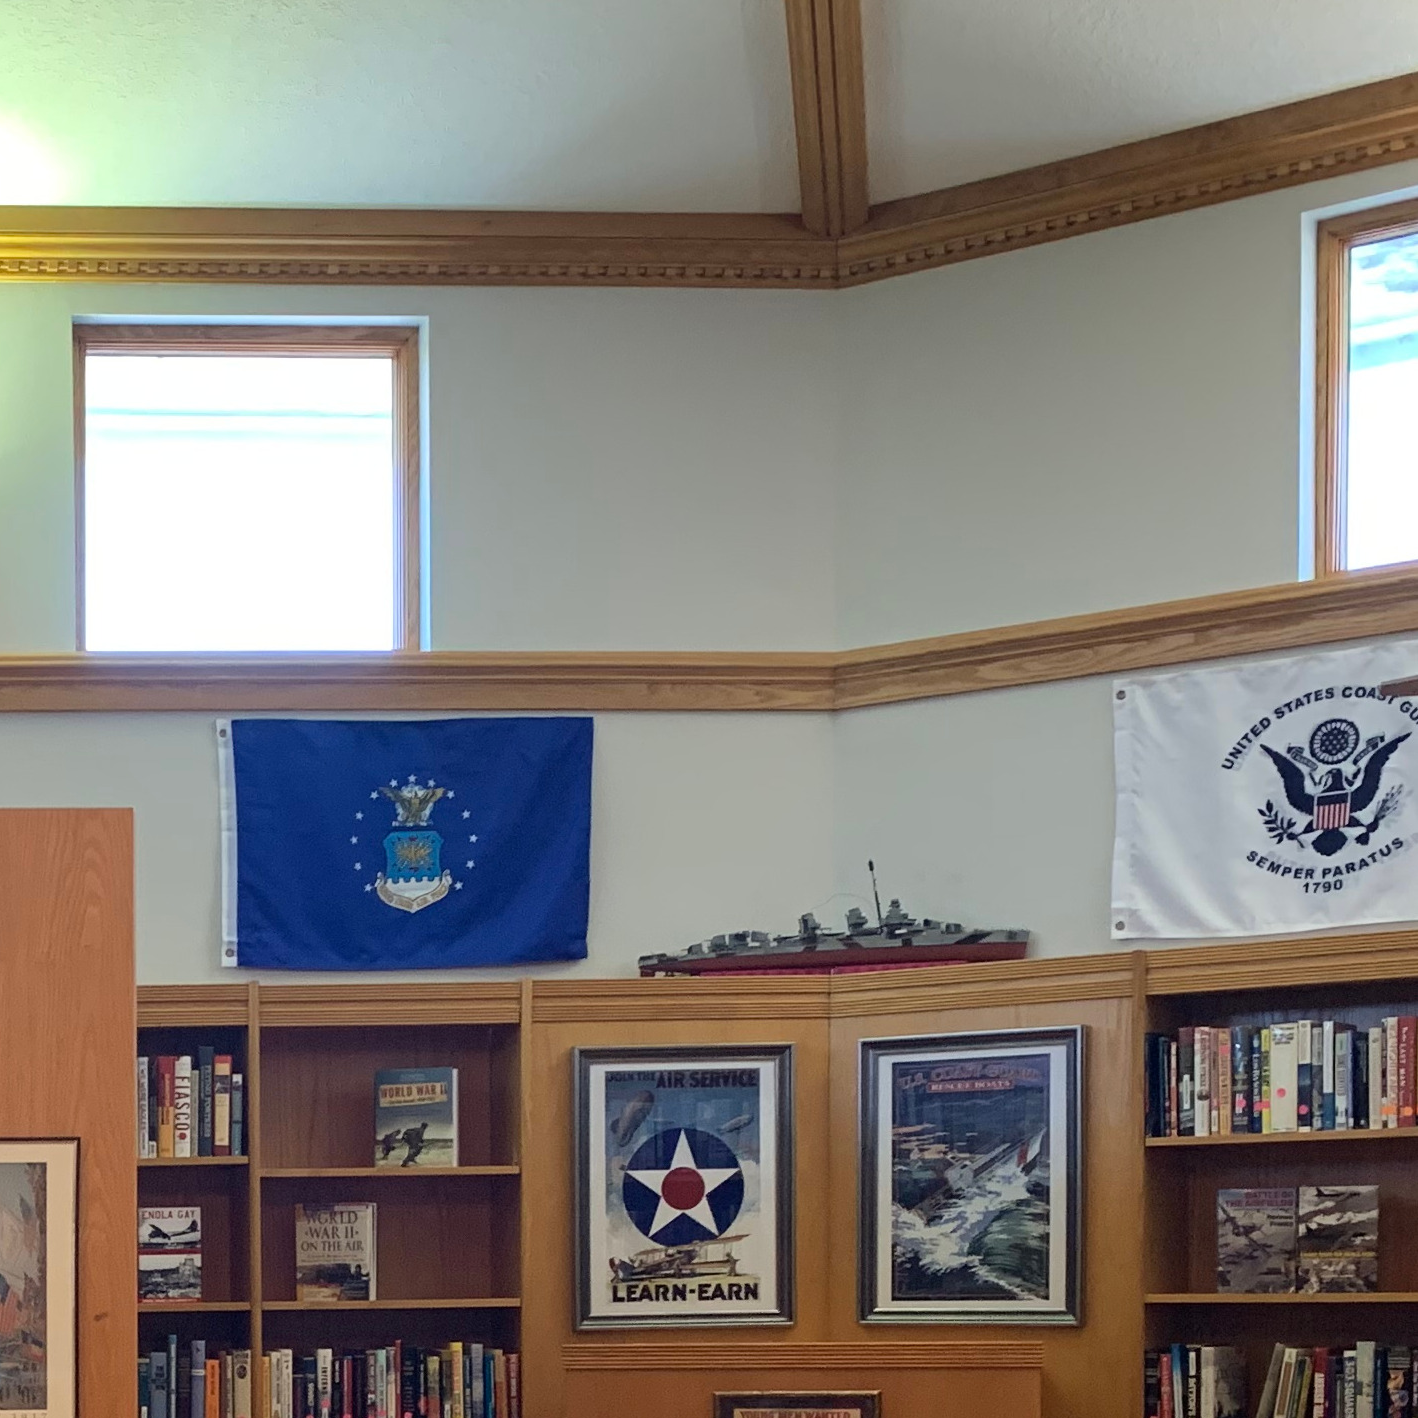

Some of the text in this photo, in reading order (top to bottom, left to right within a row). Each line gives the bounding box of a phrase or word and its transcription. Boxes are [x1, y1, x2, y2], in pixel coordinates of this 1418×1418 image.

[1221, 717, 1271, 770] UNITED
[1274, 687, 1334, 720] STATES
[1246, 837, 1403, 879] SEMPER PARATUS
[1302, 879, 1343, 893] 1790
[656, 1071, 687, 1089] AIR
[689, 1070, 758, 1087] SERVICE
[381, 1086, 412, 1098] WORLD
[417, 1085, 437, 1096] WAR
[174, 1076, 190, 1131] FIASCO
[141, 1209, 196, 1219] ENOLA GAY
[307, 1209, 358, 1225] WORLD
[309, 1226, 339, 1240] WAR
[301, 1240, 364, 1252] ON THE AIR
[612, 1283, 759, 1303] LEARN-EARN
[1344, 1360, 1355, 1380] 303
